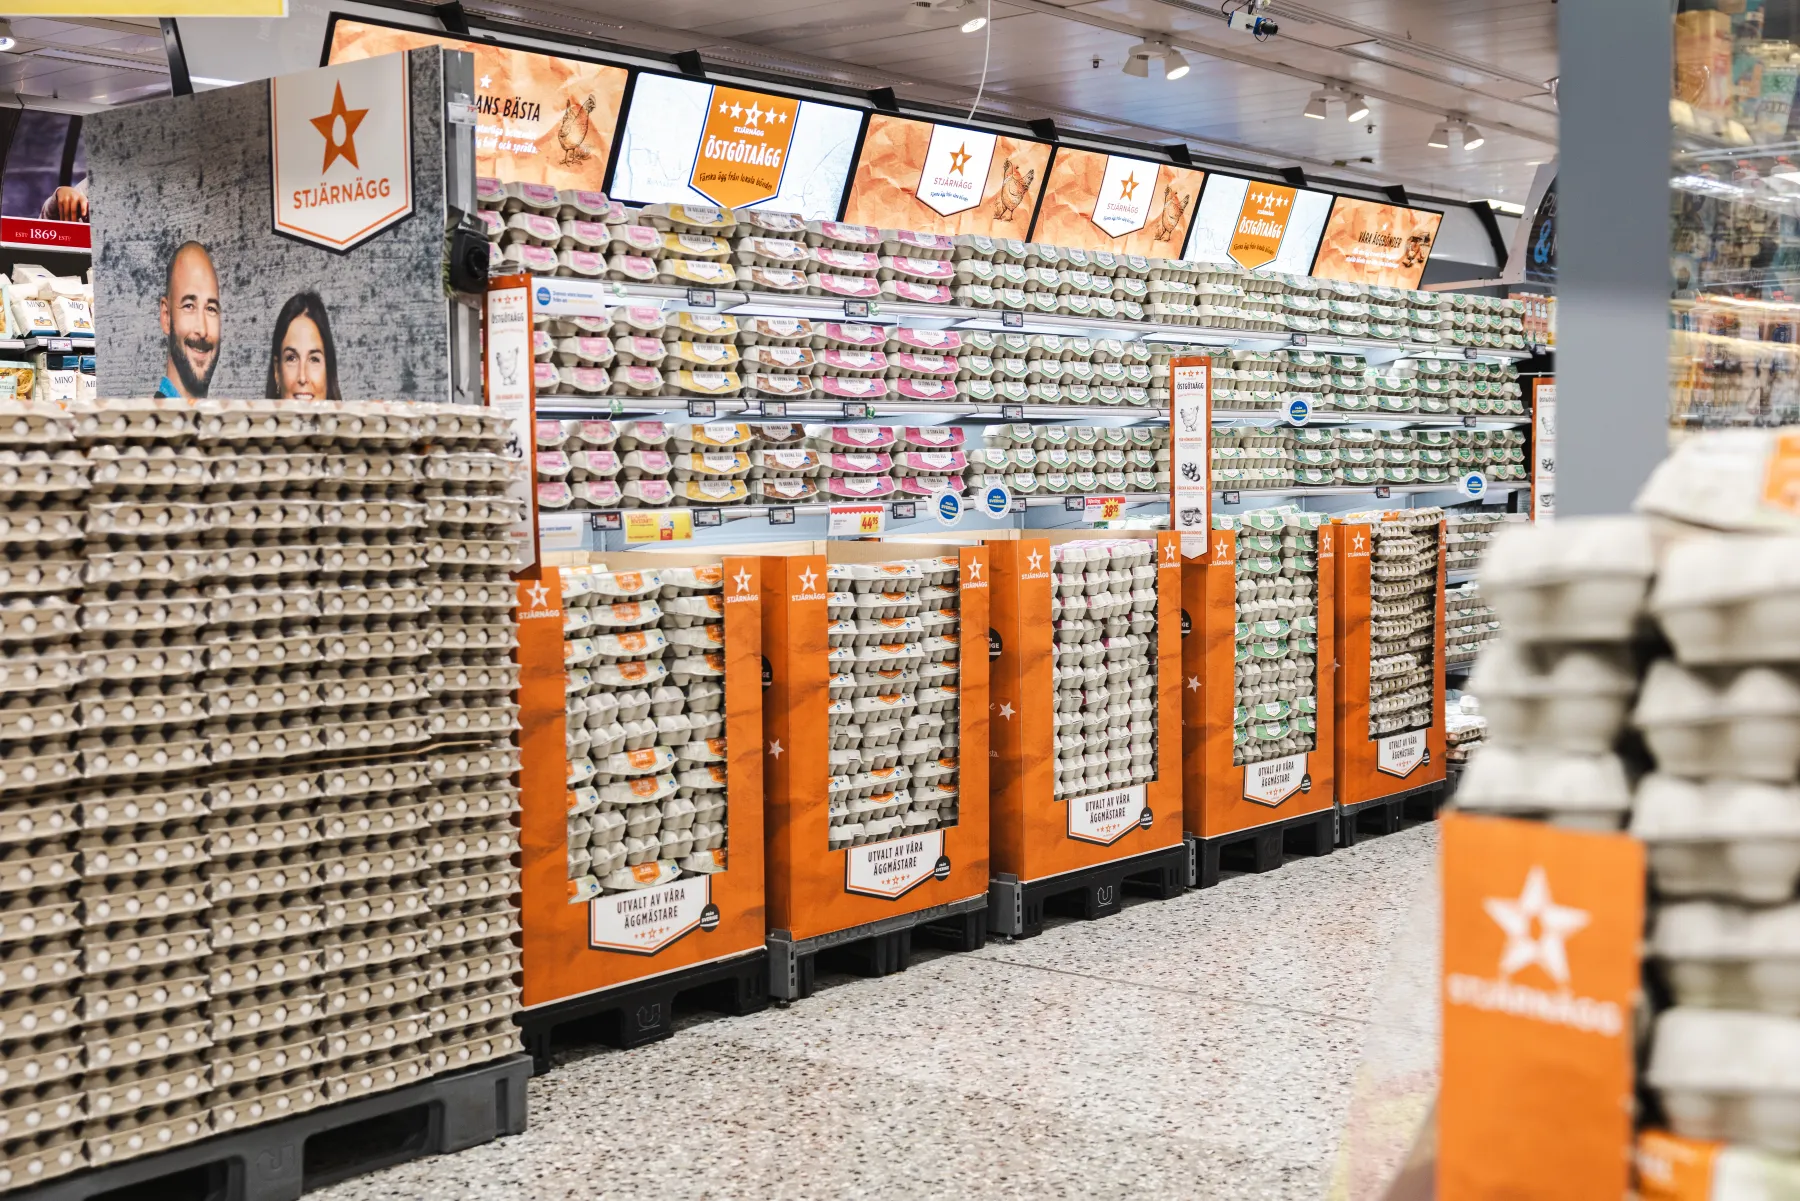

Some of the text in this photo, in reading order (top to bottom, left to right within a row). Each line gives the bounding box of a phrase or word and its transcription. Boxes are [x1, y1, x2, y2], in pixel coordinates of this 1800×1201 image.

[502, 96, 541, 122] BÄSTA
[704, 134, 782, 168] ÖSTGÖTAÄGG
[700, 172, 716, 182] Färska
[718, 172, 728, 182] ägg
[728, 171, 740, 181] från
[740, 173, 756, 184] lokala
[934, 177, 972, 190] STJÄRNÄGG
[293, 177, 390, 210] STJÄRNÄGG
[30, 228, 57, 240] 1869
[1238, 216, 1283, 239] ÖSTGÖTAÄGG
[54, 376, 74, 384] MINO
[1176, 382, 1204, 390] ÖSTGÖTAÄGG
[861, 517, 872, 529] 44
[1021, 572, 1049, 580] STJÄRNÄGG
[962, 580, 988, 590] STJÄRNÄGG
[726, 594, 759, 604] STJÄRNÄGG
[791, 592, 826, 602] STJÄRNÄGG
[518, 608, 560, 620] STJÄRNÄGG
[1258, 760, 1294, 776] UTVALT AV VÅRA
[1261, 773, 1290, 787] ÄGGMÄSTARE
[1085, 792, 1130, 812] UTVALT AV VÅRA
[1090, 807, 1126, 824] ÄGGMÄSTARE
[868, 840, 923, 862] UTVALT AV VÅRA
[873, 856, 917, 876] ÄGGMÄSTARE
[617, 888, 686, 914] UTVALT AV VÅRA
[624, 906, 678, 929] ÄGGMÄSTARE
[701, 915, 718, 923] SVERIGE
